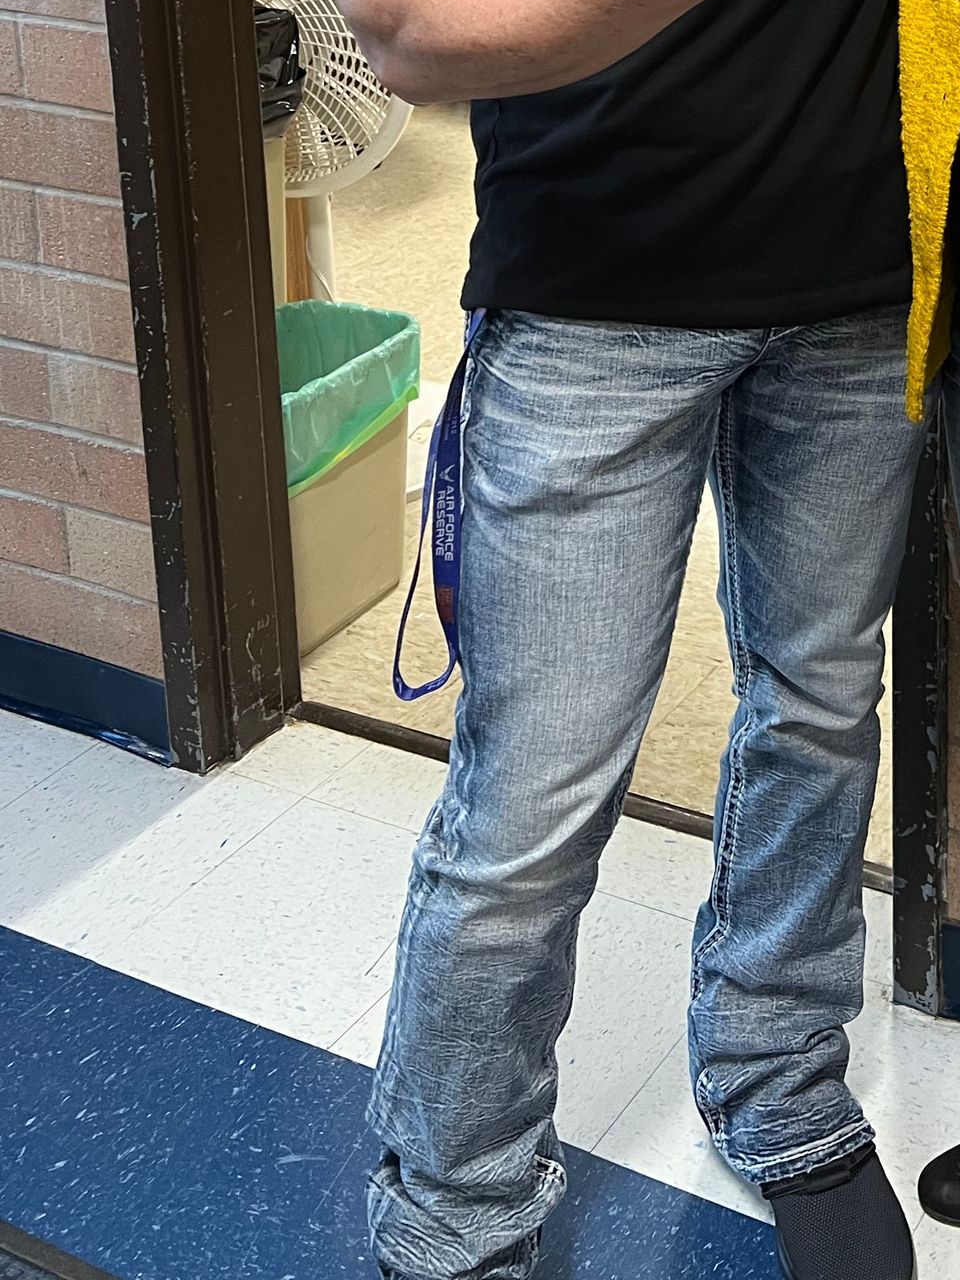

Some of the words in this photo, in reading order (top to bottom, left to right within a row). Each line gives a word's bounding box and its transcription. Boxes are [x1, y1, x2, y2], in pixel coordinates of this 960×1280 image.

[446, 485, 455, 510] AIR
[435, 490, 446, 556] RESERVE
[444, 514, 455, 561] FORCE
